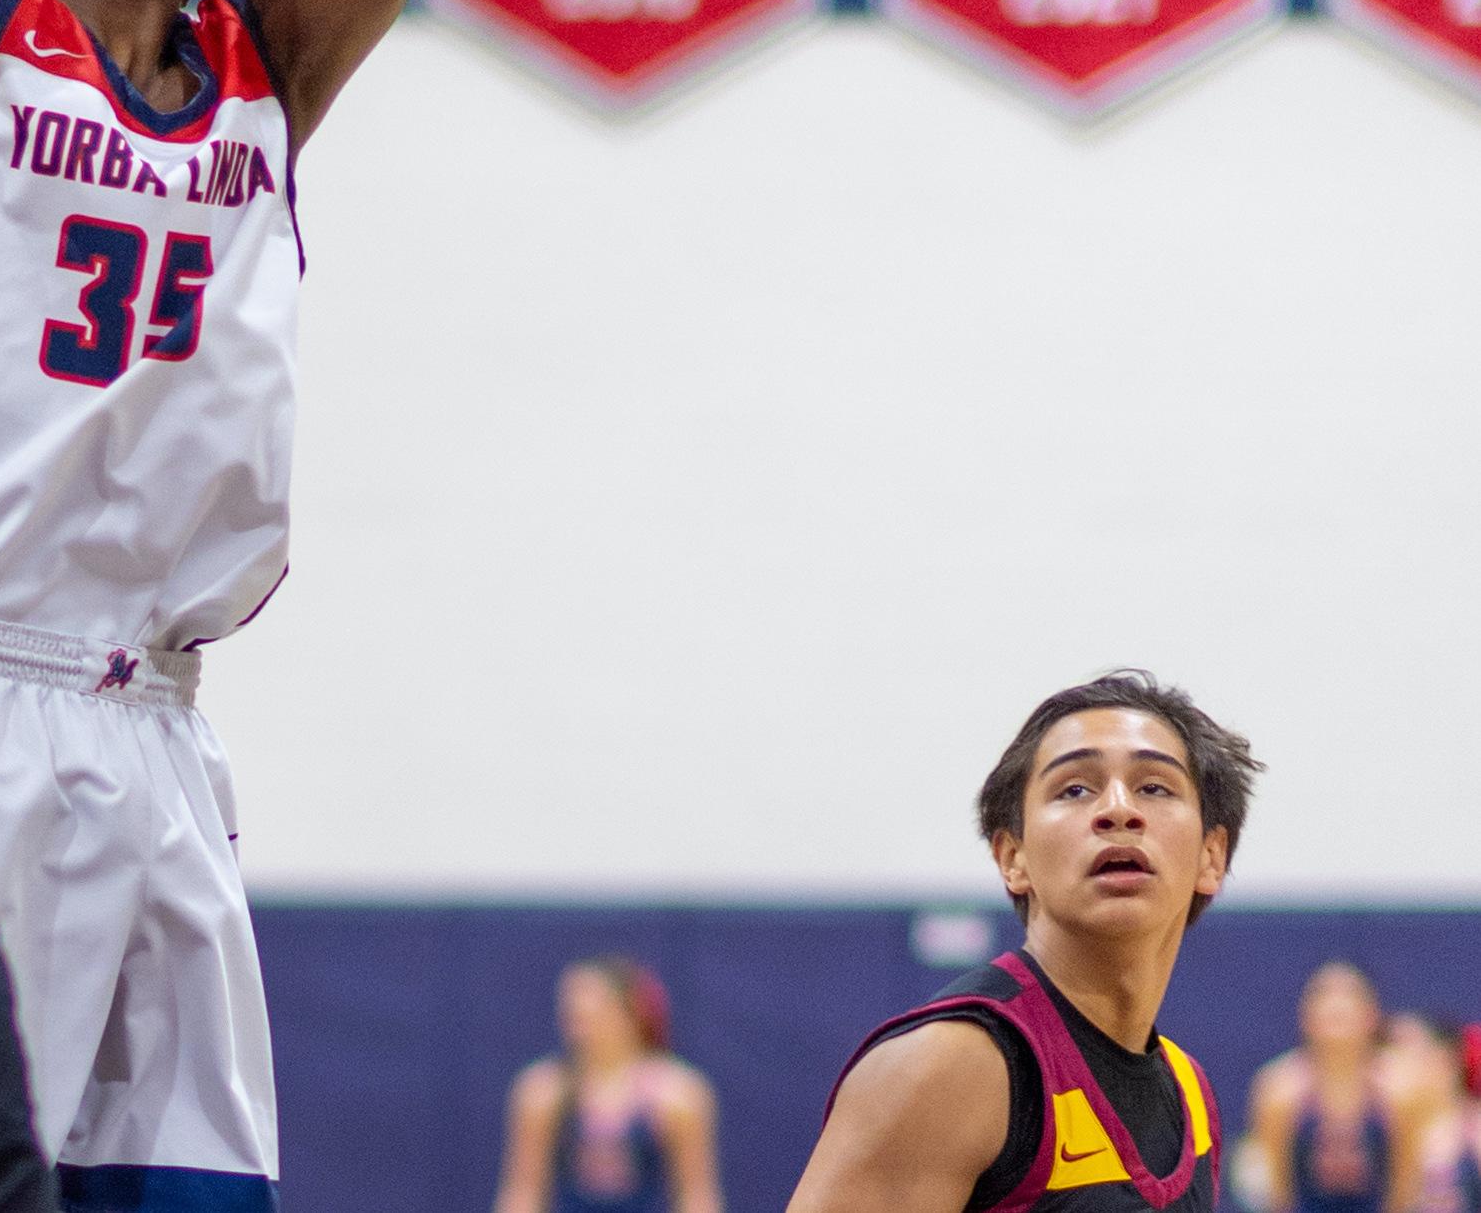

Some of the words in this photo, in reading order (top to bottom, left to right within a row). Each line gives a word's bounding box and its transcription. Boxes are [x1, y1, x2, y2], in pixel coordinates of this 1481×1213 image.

[11, 105, 168, 199] YORBA
[187, 139, 276, 208] LINDA
[39, 213, 215, 389] 35
